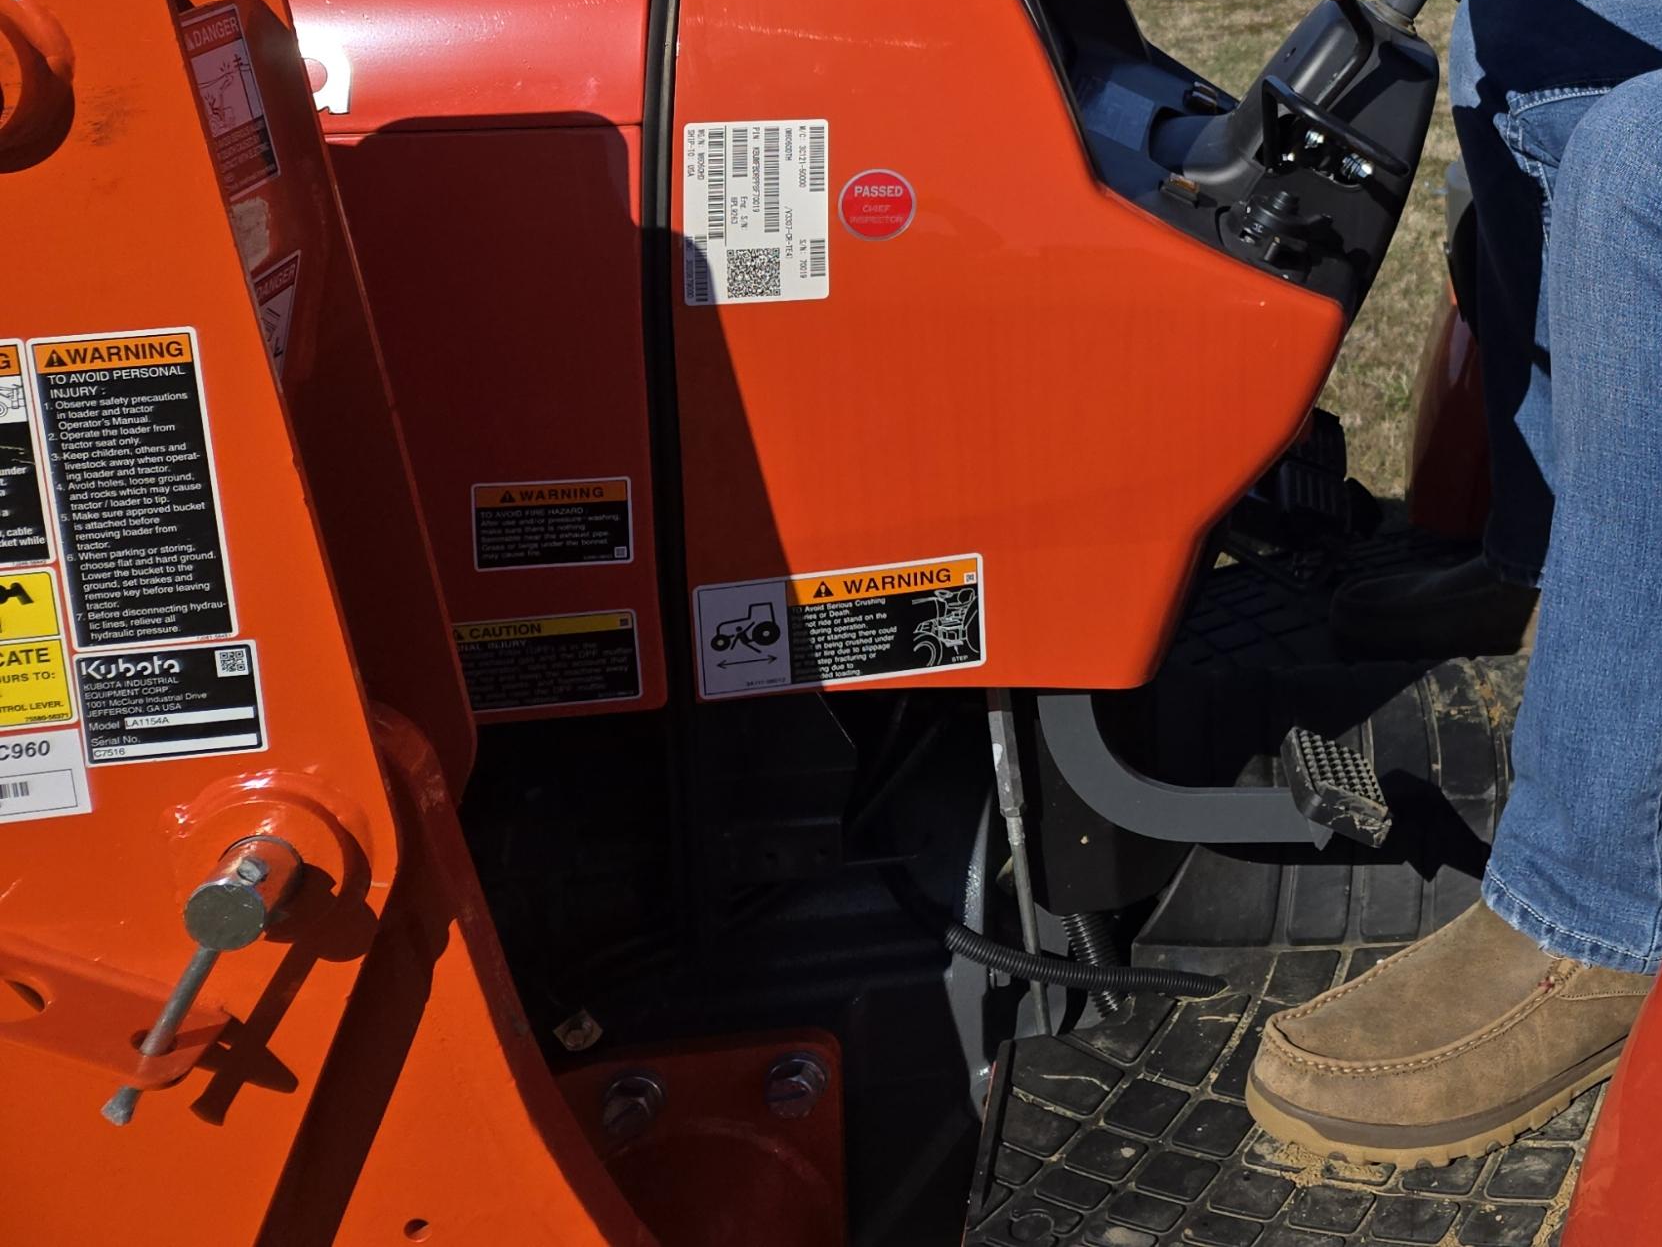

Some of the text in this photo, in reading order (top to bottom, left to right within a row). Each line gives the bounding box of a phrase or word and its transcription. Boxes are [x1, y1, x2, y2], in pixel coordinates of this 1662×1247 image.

[193, 17, 239, 47] DANGER
[854, 185, 903, 197] PASSED
[863, 204, 891, 212] CHIEF
[66, 340, 183, 365] WARNING
[48, 365, 185, 385] TO AVOID PERSONAL
[50, 386, 98, 399] INJURY
[55, 399, 96, 409] Observe
[99, 396, 128, 408] safety
[130, 391, 188, 405] precautions
[56, 404, 153, 419] in loader and tractor
[58, 414, 150, 431] Operator's Manual.
[59, 429, 100, 441] Operate
[102, 428, 117, 436] the
[120, 425, 150, 434] loader
[152, 423, 175, 431] from
[61, 436, 141, 450] tractor seat only.
[62, 451, 89, 462] Keep
[91, 447, 132, 459] children,
[134, 444, 165, 454] others
[167, 442, 186, 451] and
[64, 452, 200, 470] livestock away when operat-
[65, 464, 170, 482] ing loader and tractor.
[56, 483, 65, 491] 4.
[67, 481, 95, 490] Avoid
[97, 478, 126, 488] holes,
[129, 475, 155, 484] loose
[68, 482, 201, 501] and rocks which may cause
[520, 487, 603, 501] WARNING
[70, 500, 101, 510] tractor
[110, 497, 140, 507] loader
[143, 496, 152, 504] to
[154, 494, 169, 504] tip.
[72, 511, 99, 520] Make
[125, 504, 170, 517] approved
[172, 501, 205, 512] bucket
[84, 519, 126, 529] attached
[128, 515, 160, 525] before
[6, 526, 33, 537] cable
[75, 524, 177, 542] removing loader from
[19, 535, 46, 546] while
[77, 540, 110, 550] tractor.
[78, 551, 107, 560] When
[109, 547, 145, 559] parking
[79, 550, 216, 570] choose flat and hard ground.
[81, 563, 193, 580] Lower the bucket to the
[122, 579, 137, 587] set
[139, 575, 172, 585] brakes
[174, 573, 192, 581] and
[843, 568, 950, 594] WARNING
[84, 581, 210, 600] remove key before leaving
[76, 599, 225, 621] 7. Before disconnecting hydrau-
[86, 600, 119, 610] tractor.
[804, 596, 885, 612] Avoid Serious Crushing
[89, 614, 175, 630] lic lines, relieve all
[809, 622, 867, 635] during operation.
[90, 628, 134, 642] hydraulic
[136, 624, 181, 637] pressure.
[468, 623, 541, 638] CAUTION
[80, 654, 180, 681] Kubota
[0, 671, 56, 684] URS TO:
[83, 676, 178, 691] KUBOTA INDUSTRIAL
[84, 688, 139, 700] EQUIPMENT
[86, 691, 207, 709] 1001 McClure Industrial Drive
[29, 700, 64, 711] LEVER.
[146, 704, 160, 712] GA
[162, 702, 181, 711] USA
[88, 715, 169, 731] Model LA1154A
[90, 734, 140, 746] Serial No.
[93, 747, 125, 757] C7516
